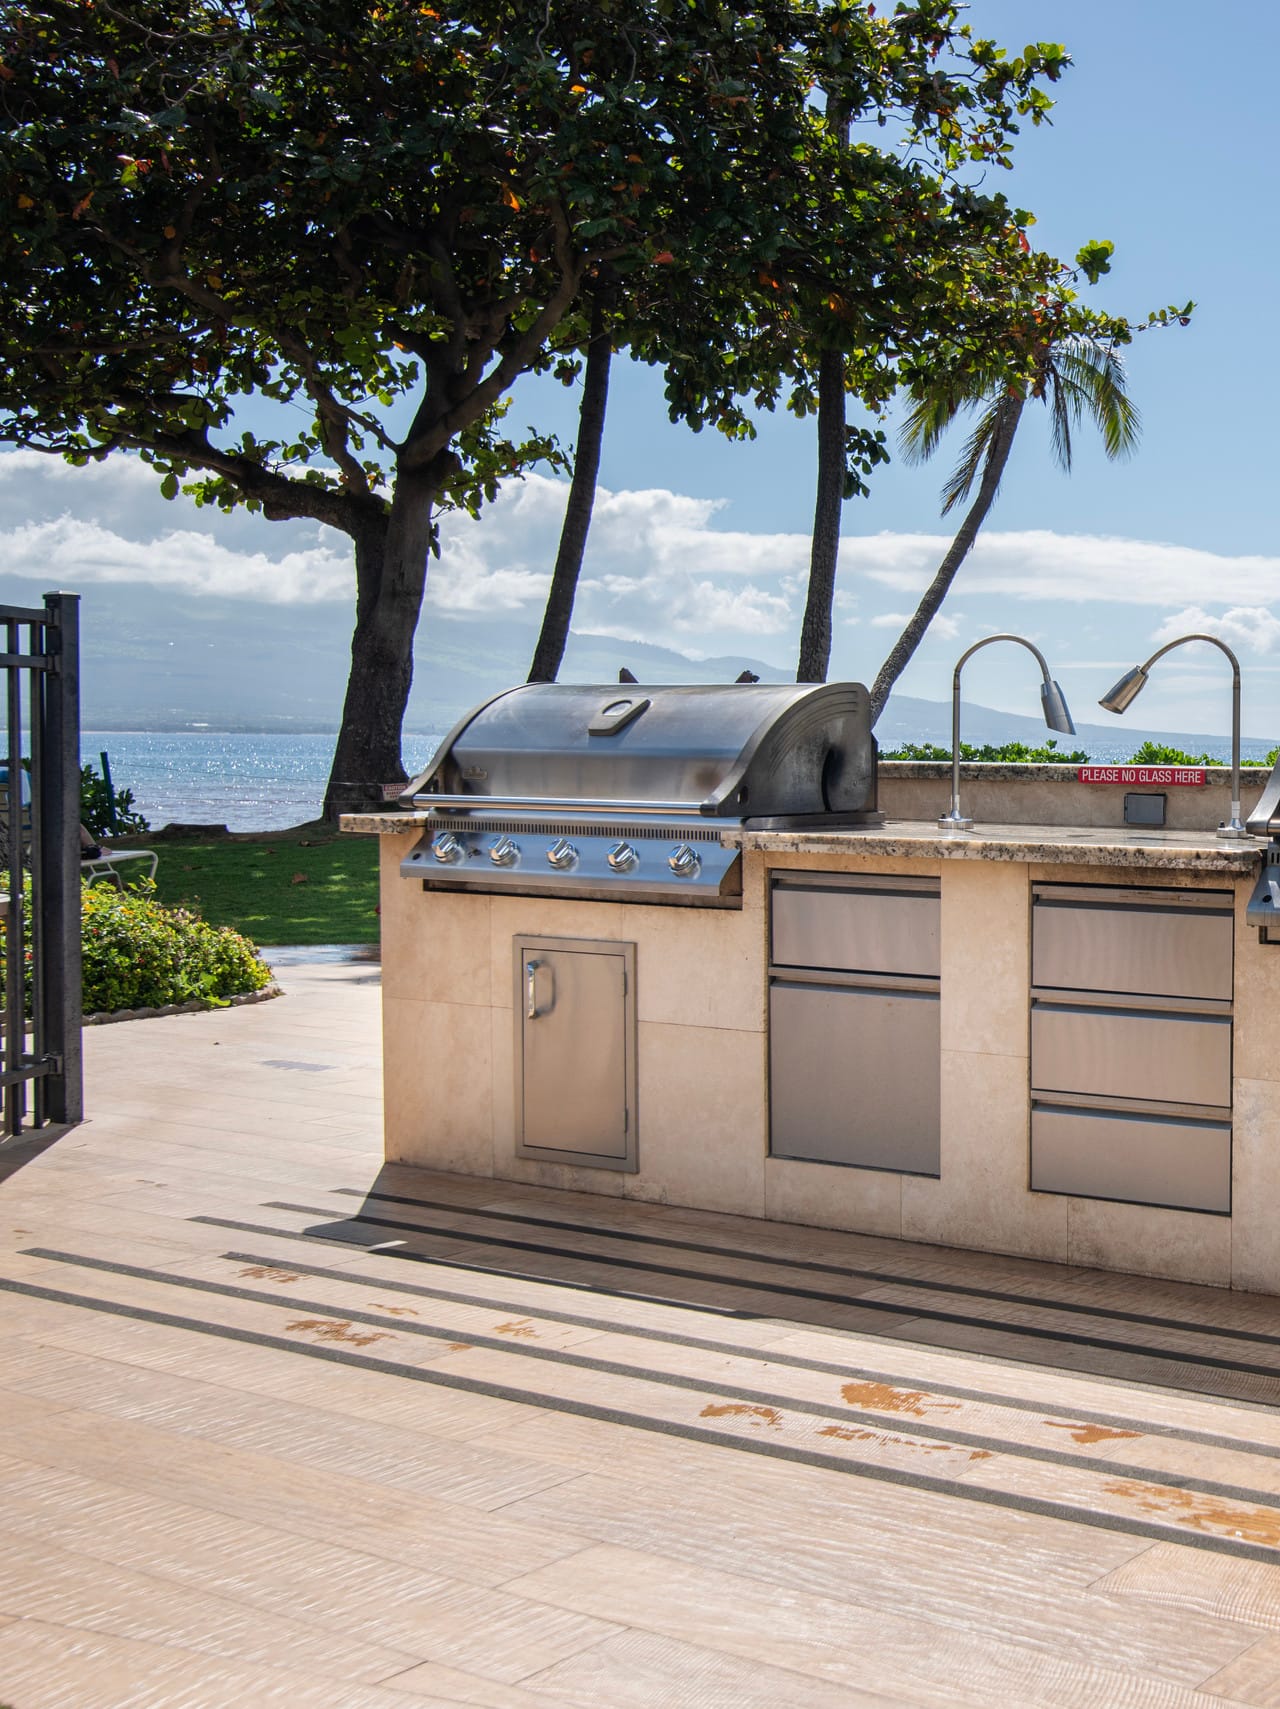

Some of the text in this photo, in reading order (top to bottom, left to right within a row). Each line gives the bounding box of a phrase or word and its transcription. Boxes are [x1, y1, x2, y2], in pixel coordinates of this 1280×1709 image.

[1082, 769, 1201, 783] PLEASE NO GLASS HERE
